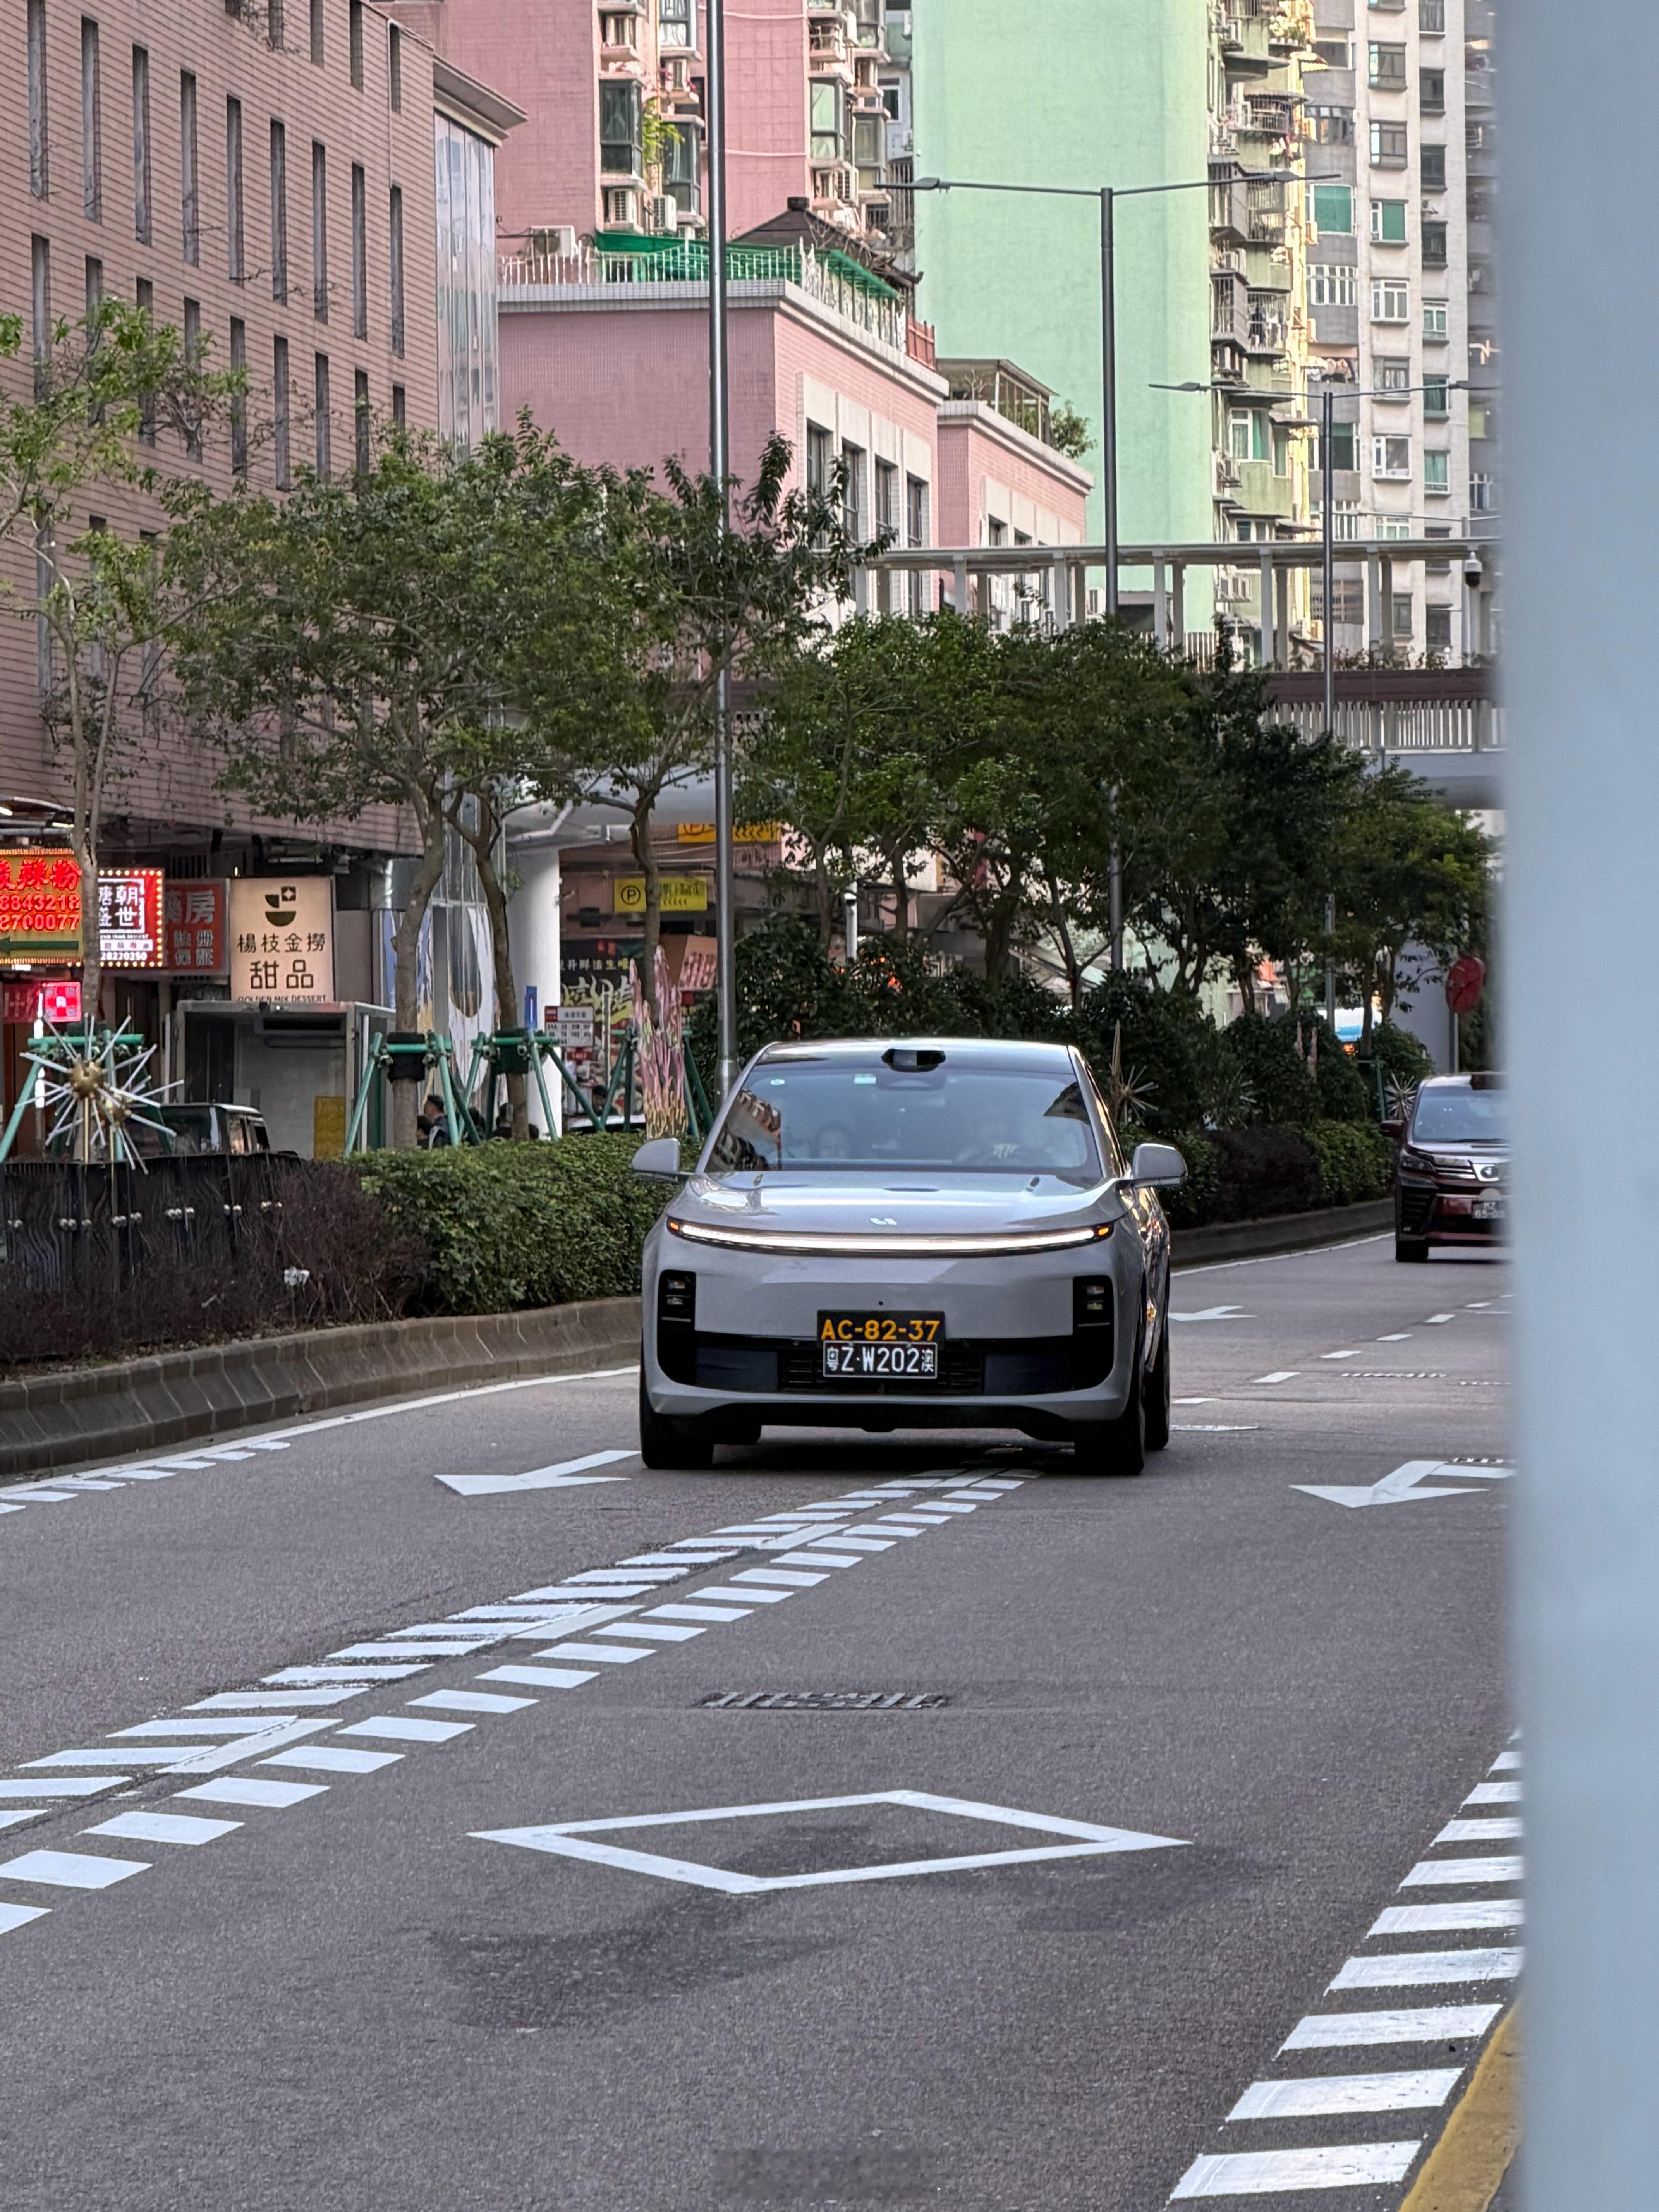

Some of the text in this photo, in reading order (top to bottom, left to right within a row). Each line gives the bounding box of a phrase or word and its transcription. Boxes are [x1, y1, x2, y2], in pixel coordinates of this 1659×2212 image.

[237, 932, 325, 953] 楊枝金撈
[250, 959, 314, 989] 甜品
[821, 1319, 940, 1341] AC-82-37
